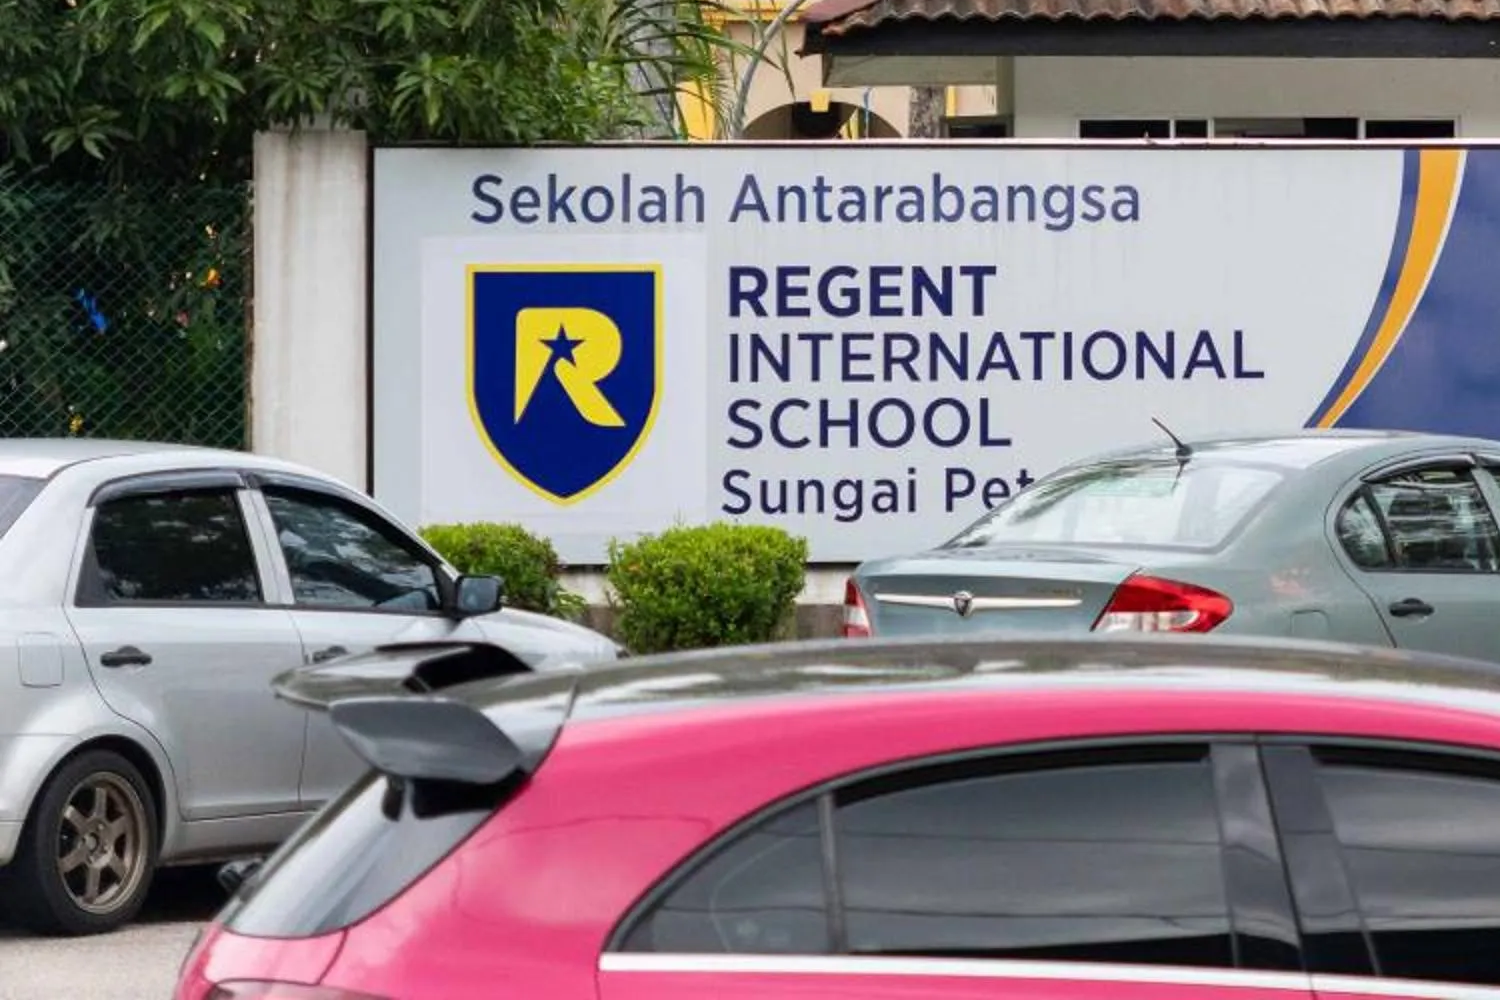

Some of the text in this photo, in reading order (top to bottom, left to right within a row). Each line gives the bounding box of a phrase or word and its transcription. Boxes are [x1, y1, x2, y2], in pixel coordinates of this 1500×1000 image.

[470, 172, 1141, 232] Sekolah Antarabangsa
[729, 265, 998, 318] REGENT
[729, 329, 1266, 383] INTERNATIONAL
[727, 397, 1012, 450] SCHOOL
[721, 467, 1035, 523] Sungai Pet
